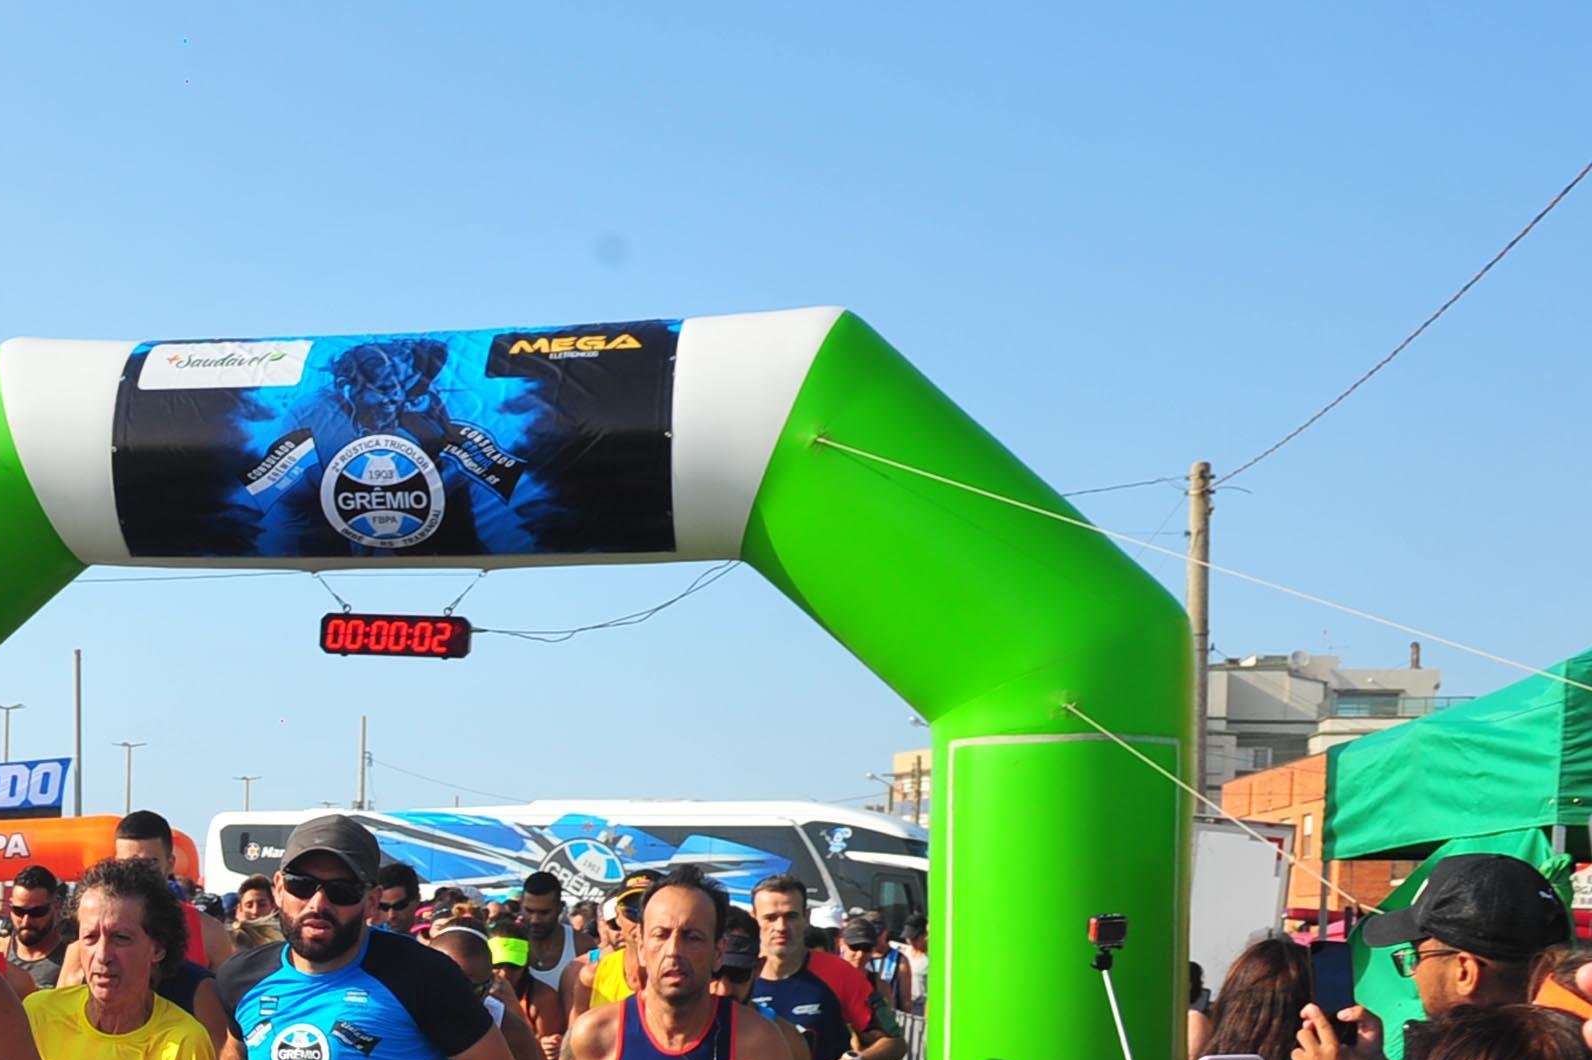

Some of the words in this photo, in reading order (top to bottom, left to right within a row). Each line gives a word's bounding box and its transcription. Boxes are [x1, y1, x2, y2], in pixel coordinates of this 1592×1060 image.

[509, 333, 643, 354] MEGA
[246, 439, 296, 480] CONSULADO
[383, 439, 430, 471] TRICOLOR
[459, 427, 517, 468] CONSULADO
[368, 469, 394, 480] 1903
[337, 487, 428, 511] GRÊMIO
[326, 619, 452, 653] 00:00:02
